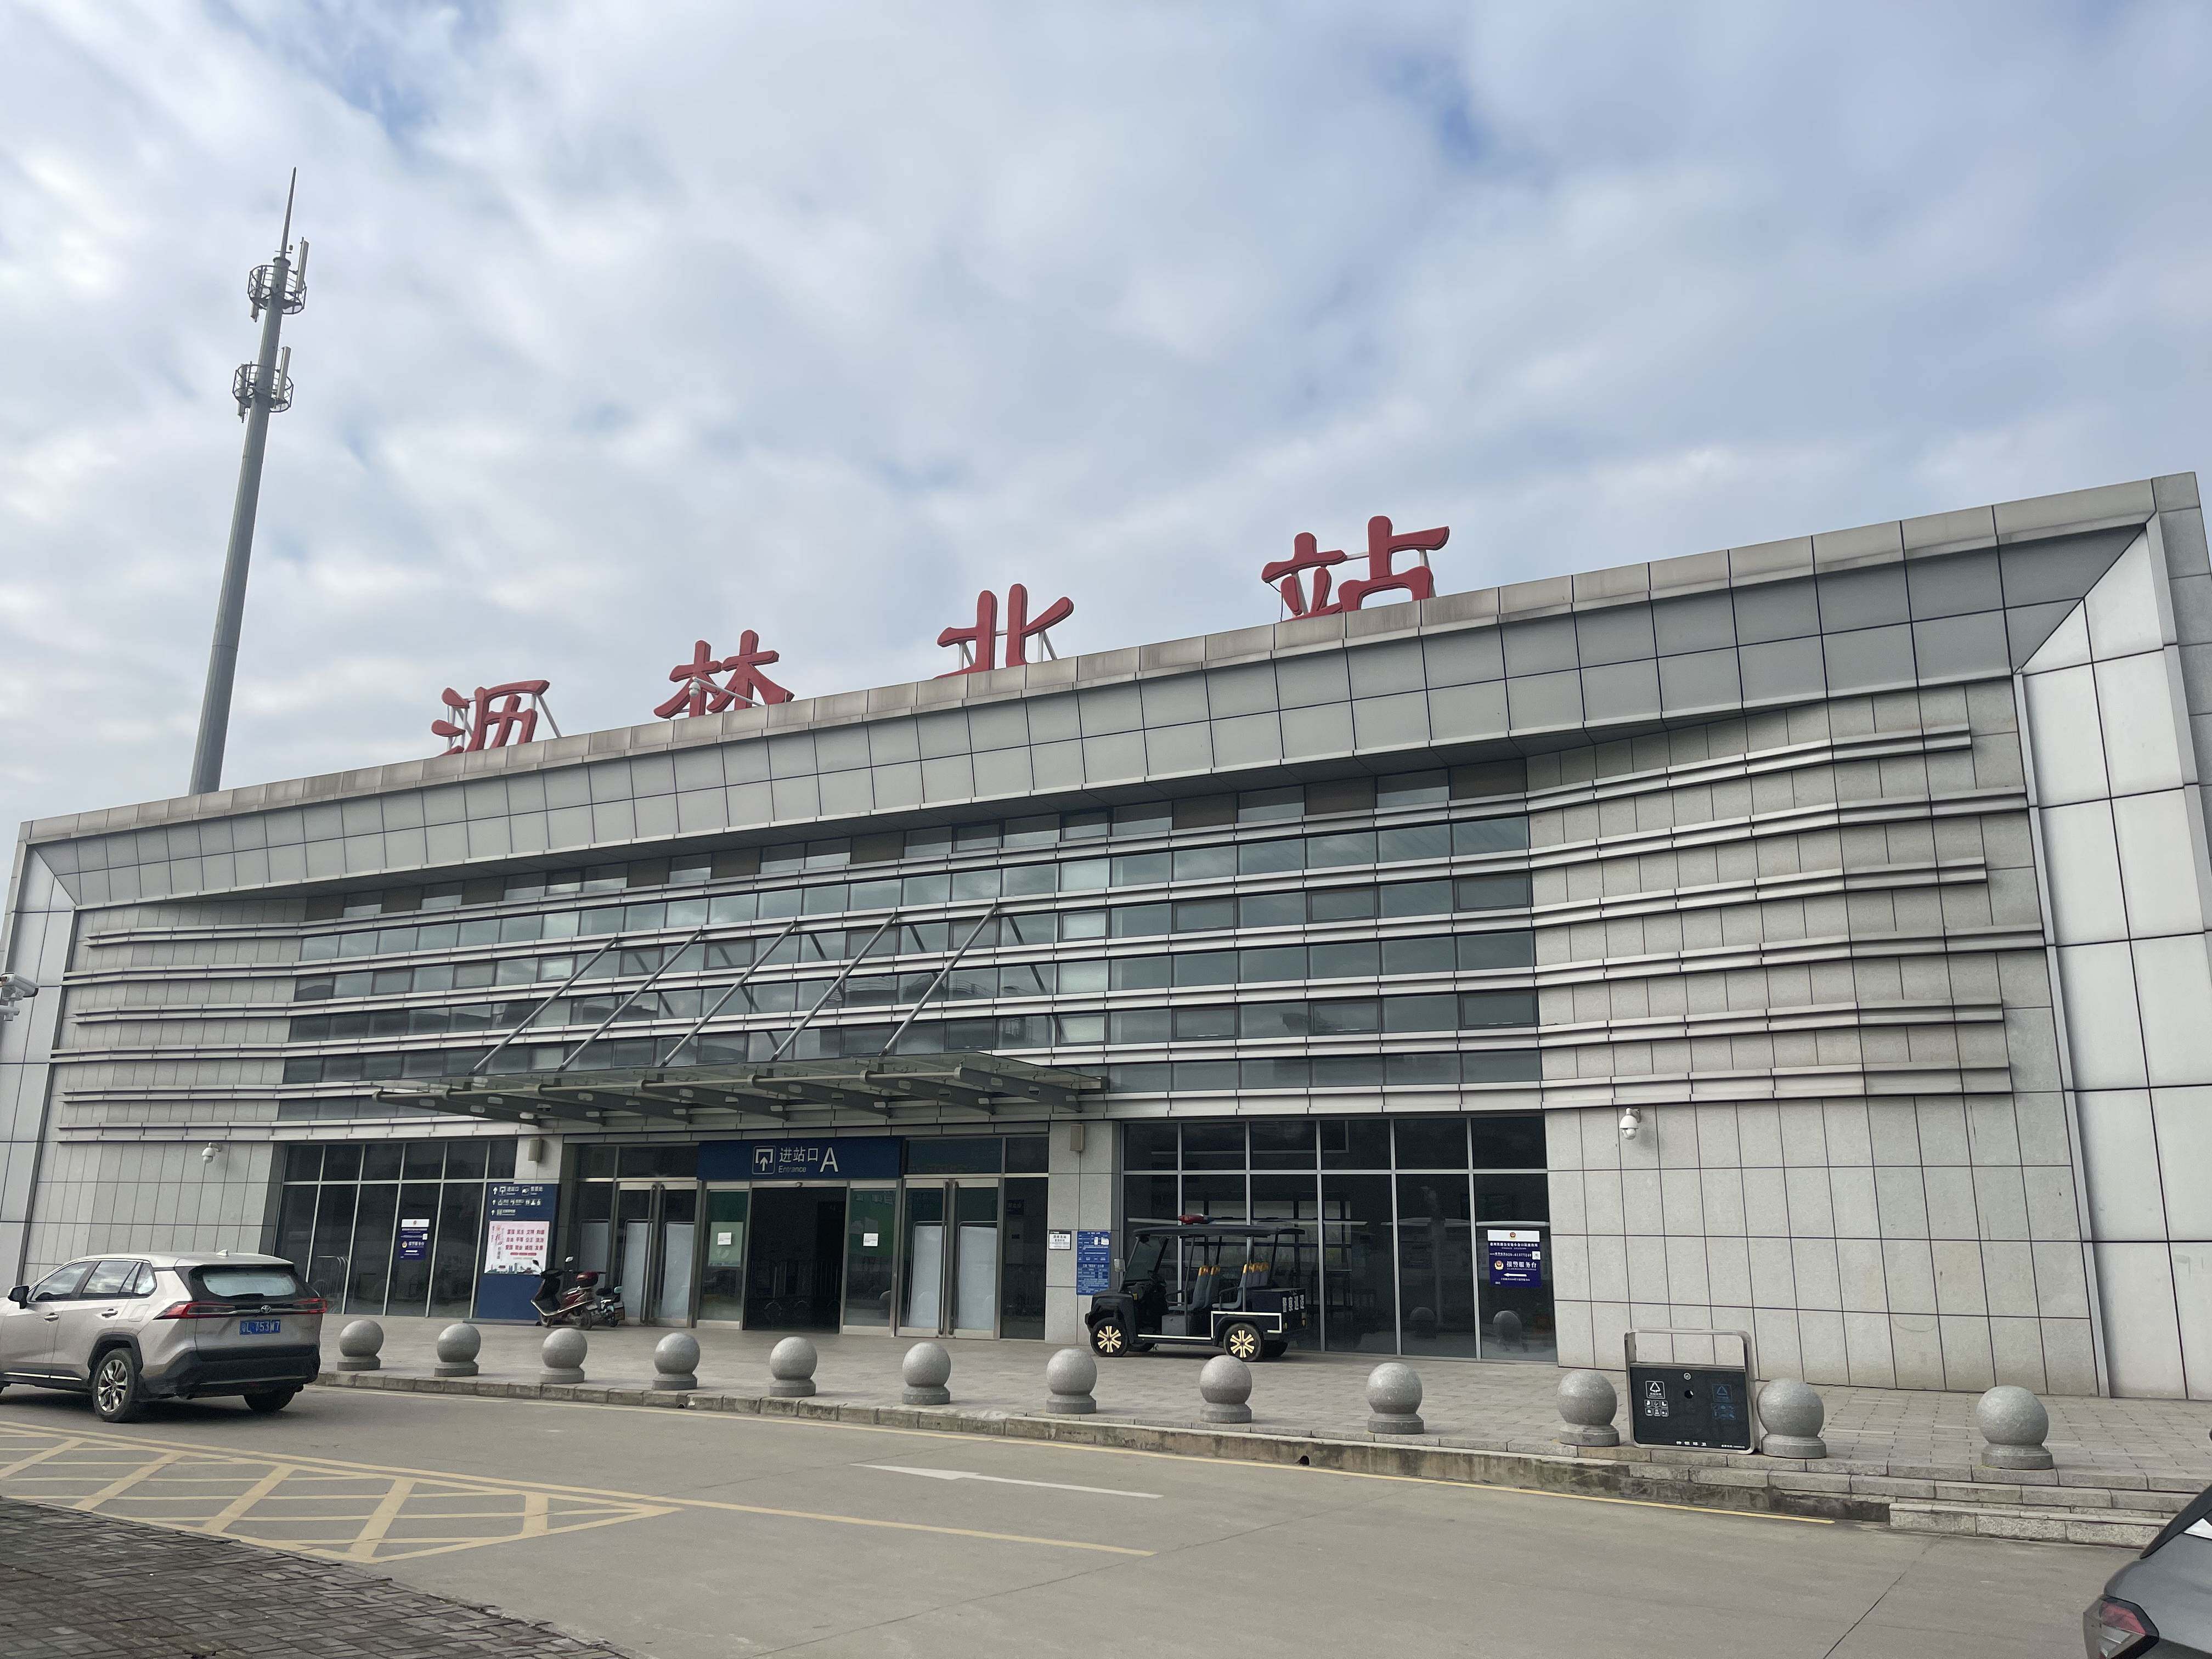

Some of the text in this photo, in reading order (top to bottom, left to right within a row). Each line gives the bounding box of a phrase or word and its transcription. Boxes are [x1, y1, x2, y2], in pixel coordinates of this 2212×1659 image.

[431, 516, 1449, 756] 沥林北站
[779, 1147, 819, 1163] 进站口
[819, 1147, 839, 1172] A
